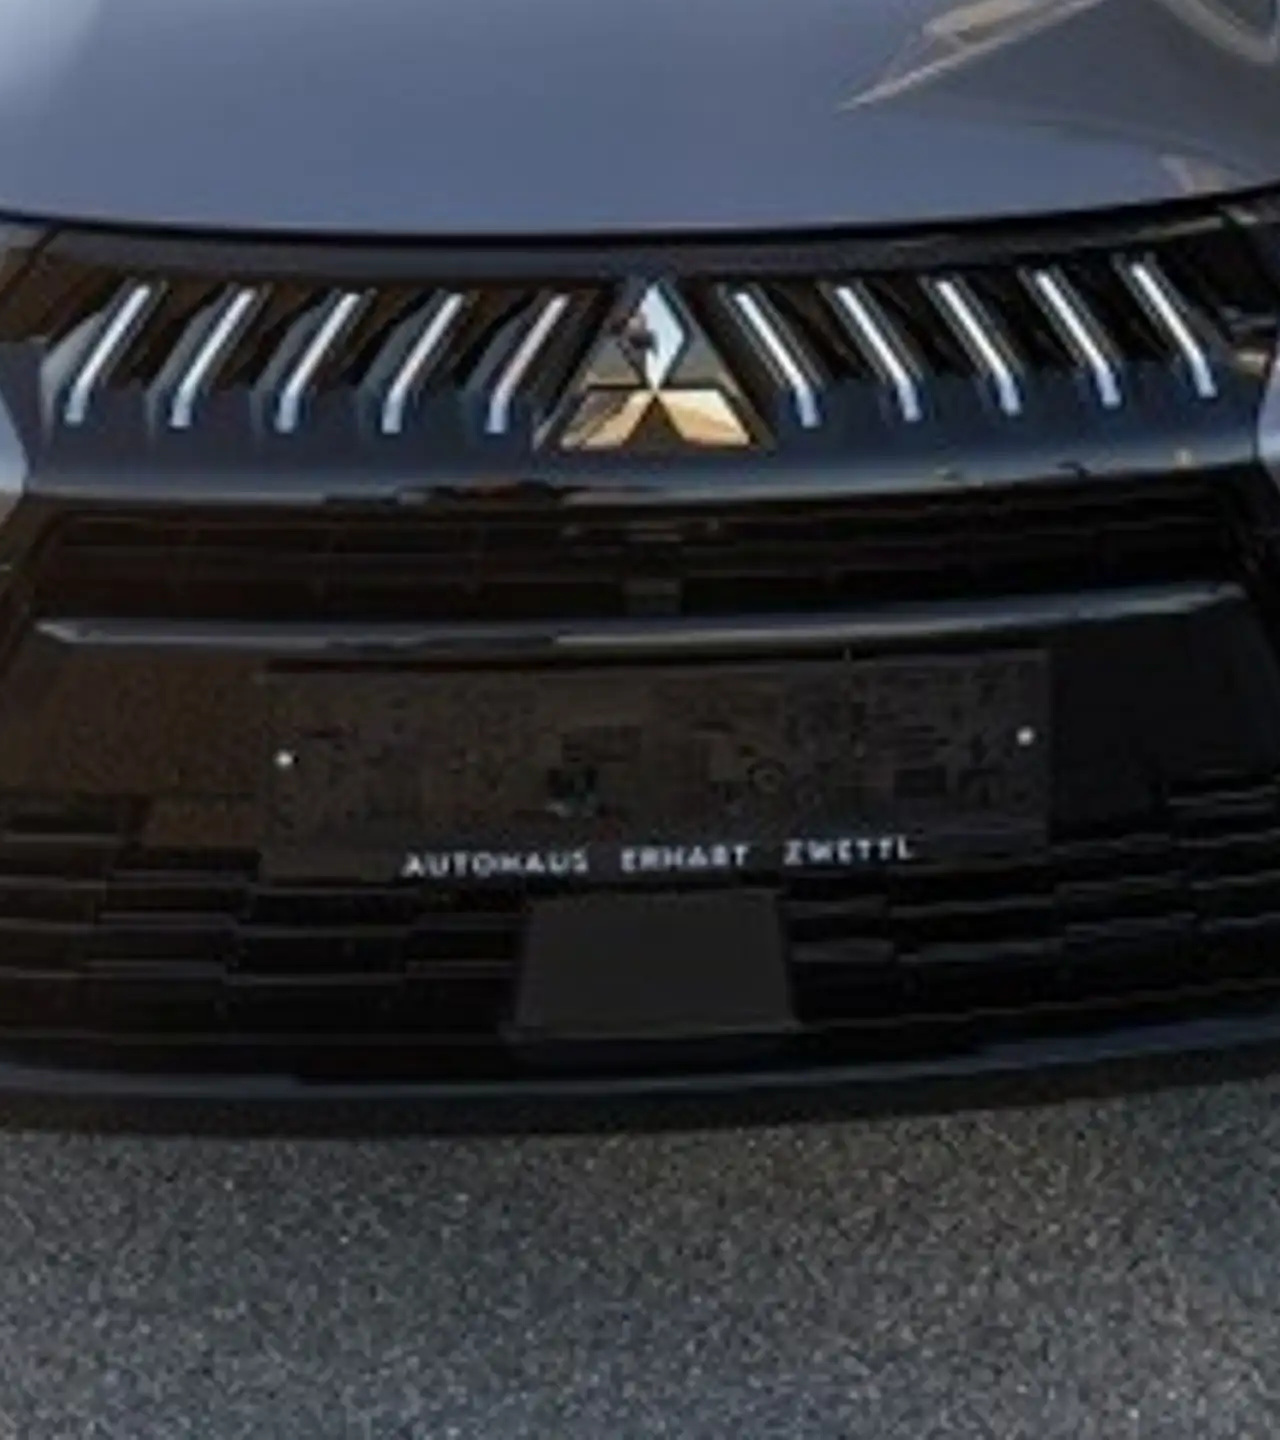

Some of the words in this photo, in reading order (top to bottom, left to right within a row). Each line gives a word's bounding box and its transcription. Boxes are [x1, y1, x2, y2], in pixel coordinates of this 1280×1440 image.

[400, 846, 591, 879] AUTOHAUS
[619, 841, 751, 873] ERHART
[783, 834, 916, 867] ZWETTL
